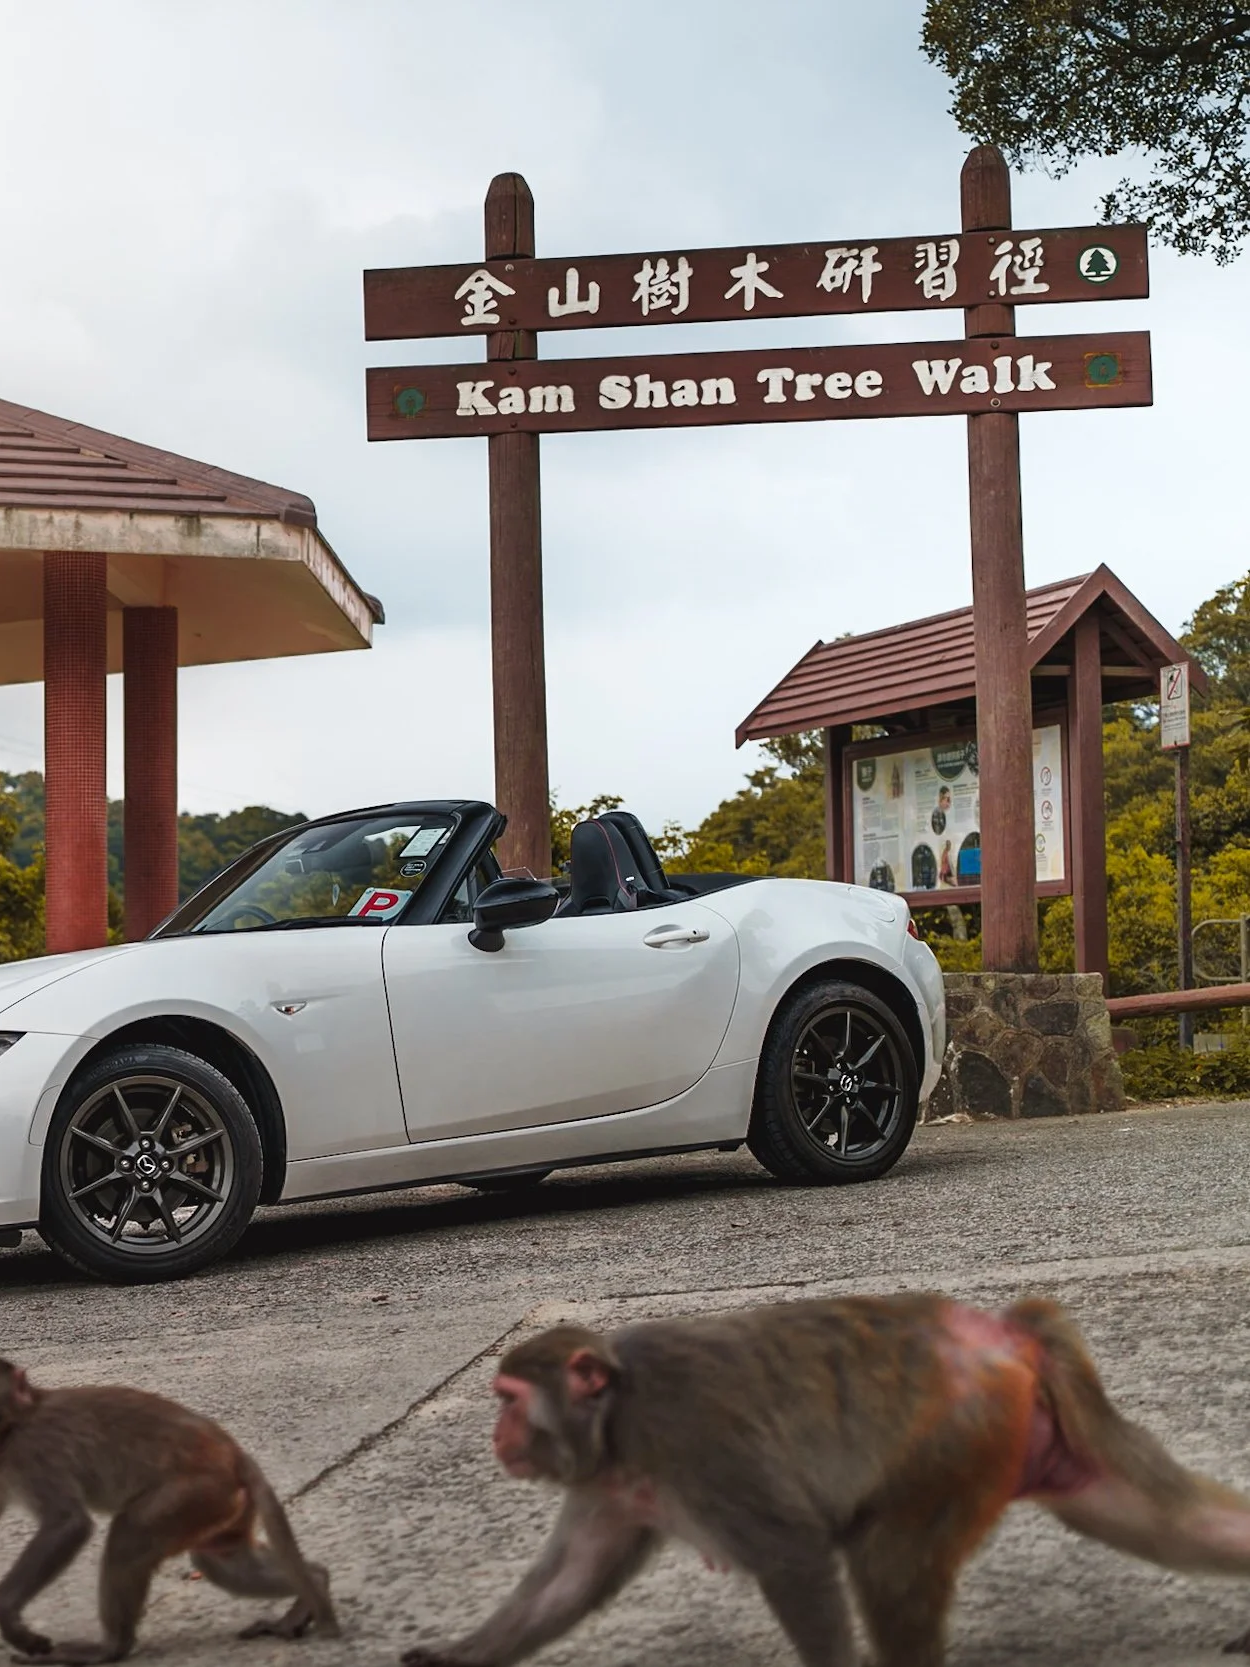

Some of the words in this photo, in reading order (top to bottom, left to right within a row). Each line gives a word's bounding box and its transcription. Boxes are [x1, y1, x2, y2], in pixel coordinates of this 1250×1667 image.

[455, 380, 575, 416] Kam
[599, 374, 737, 410] Shan
[756, 367, 883, 403] Tree
[911, 354, 1057, 396] Walk
[357, 892, 399, 917] P
